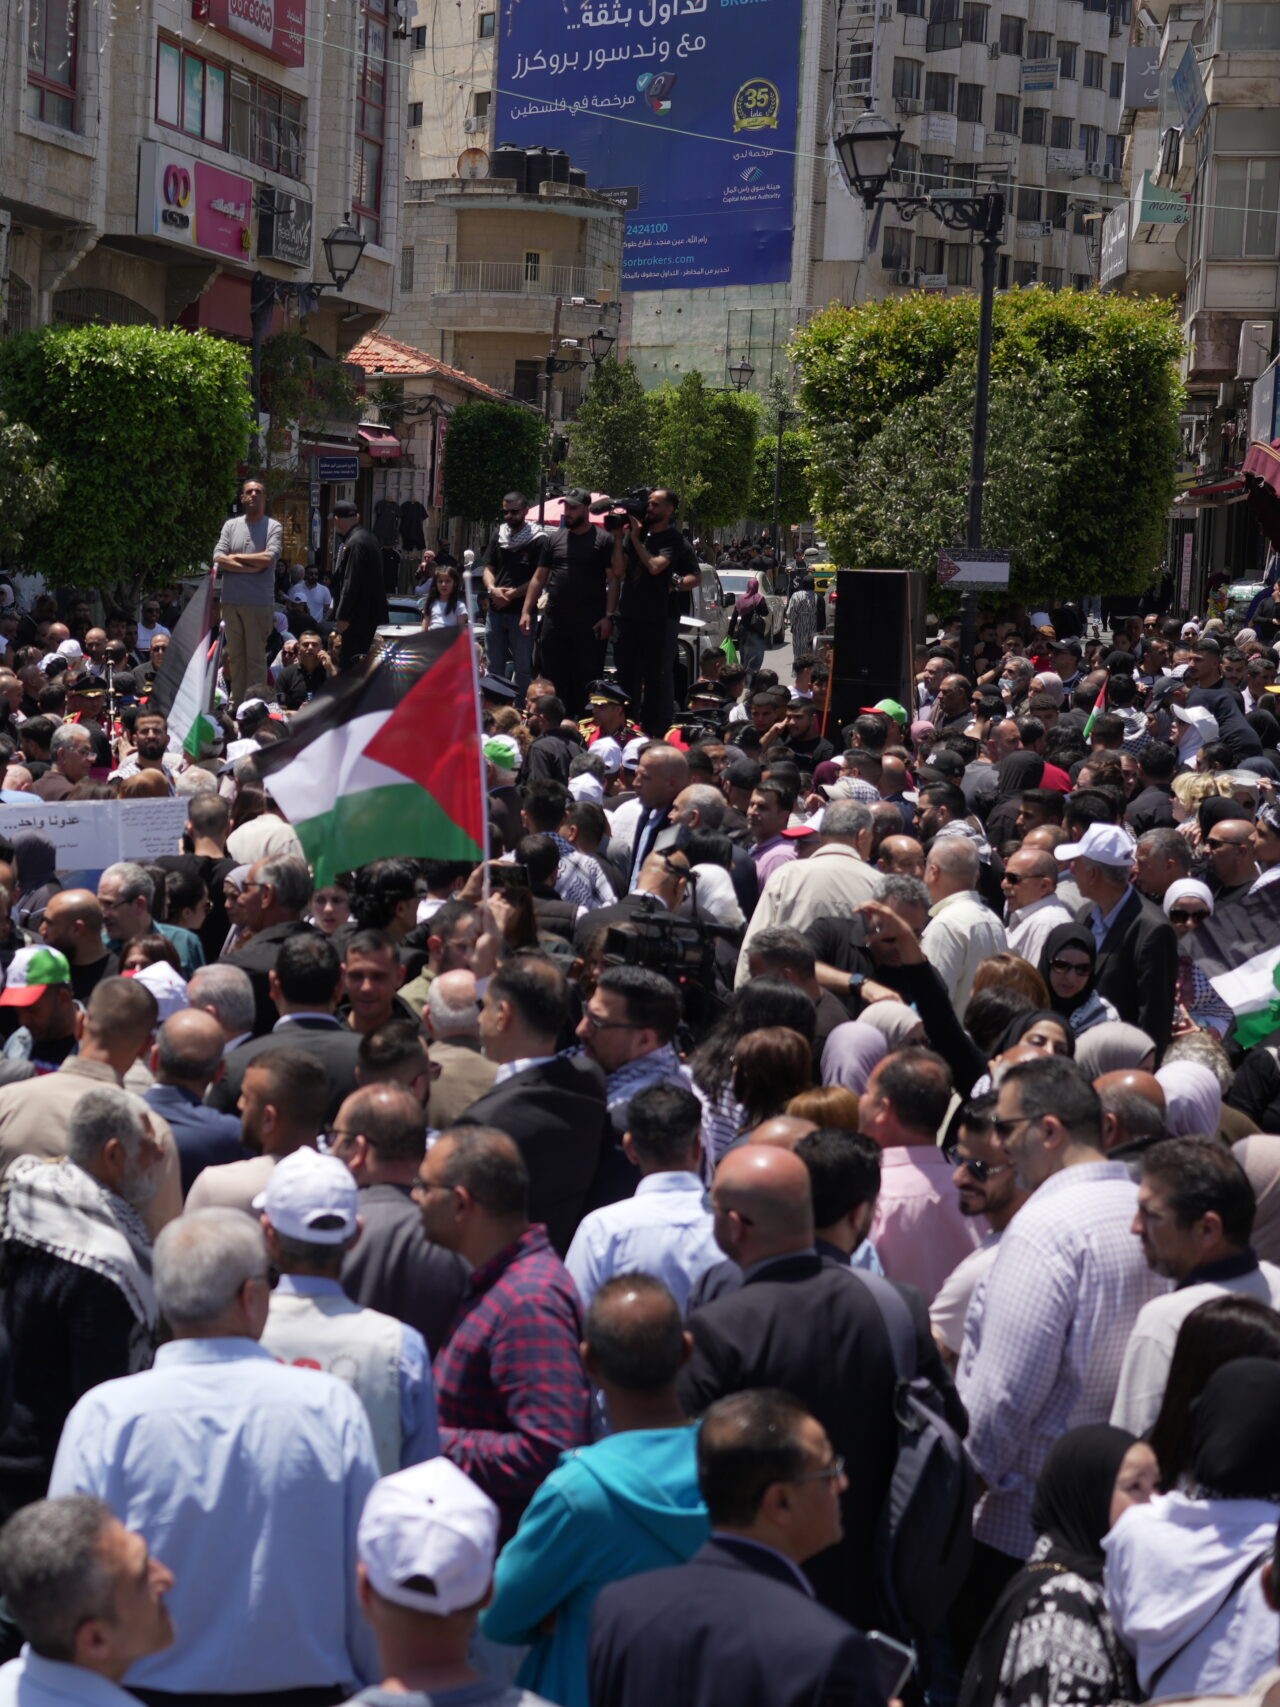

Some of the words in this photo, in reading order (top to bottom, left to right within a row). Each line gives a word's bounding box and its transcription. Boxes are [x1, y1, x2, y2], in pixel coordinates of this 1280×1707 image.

[582, 36, 670, 72] وندسور
[676, 33, 706, 58] مع
[511, 49, 579, 80] بروكرز
[510, 97, 566, 120] فلسطين
[569, 95, 589, 117] في
[591, 94, 635, 109] مرخصة
[743, 87, 770, 109] 35
[722, 195, 739, 203] Capital
[757, 192, 781, 200] Authority
[626, 223, 669, 236] 2424100
[48, 814, 80, 830] عدونا
